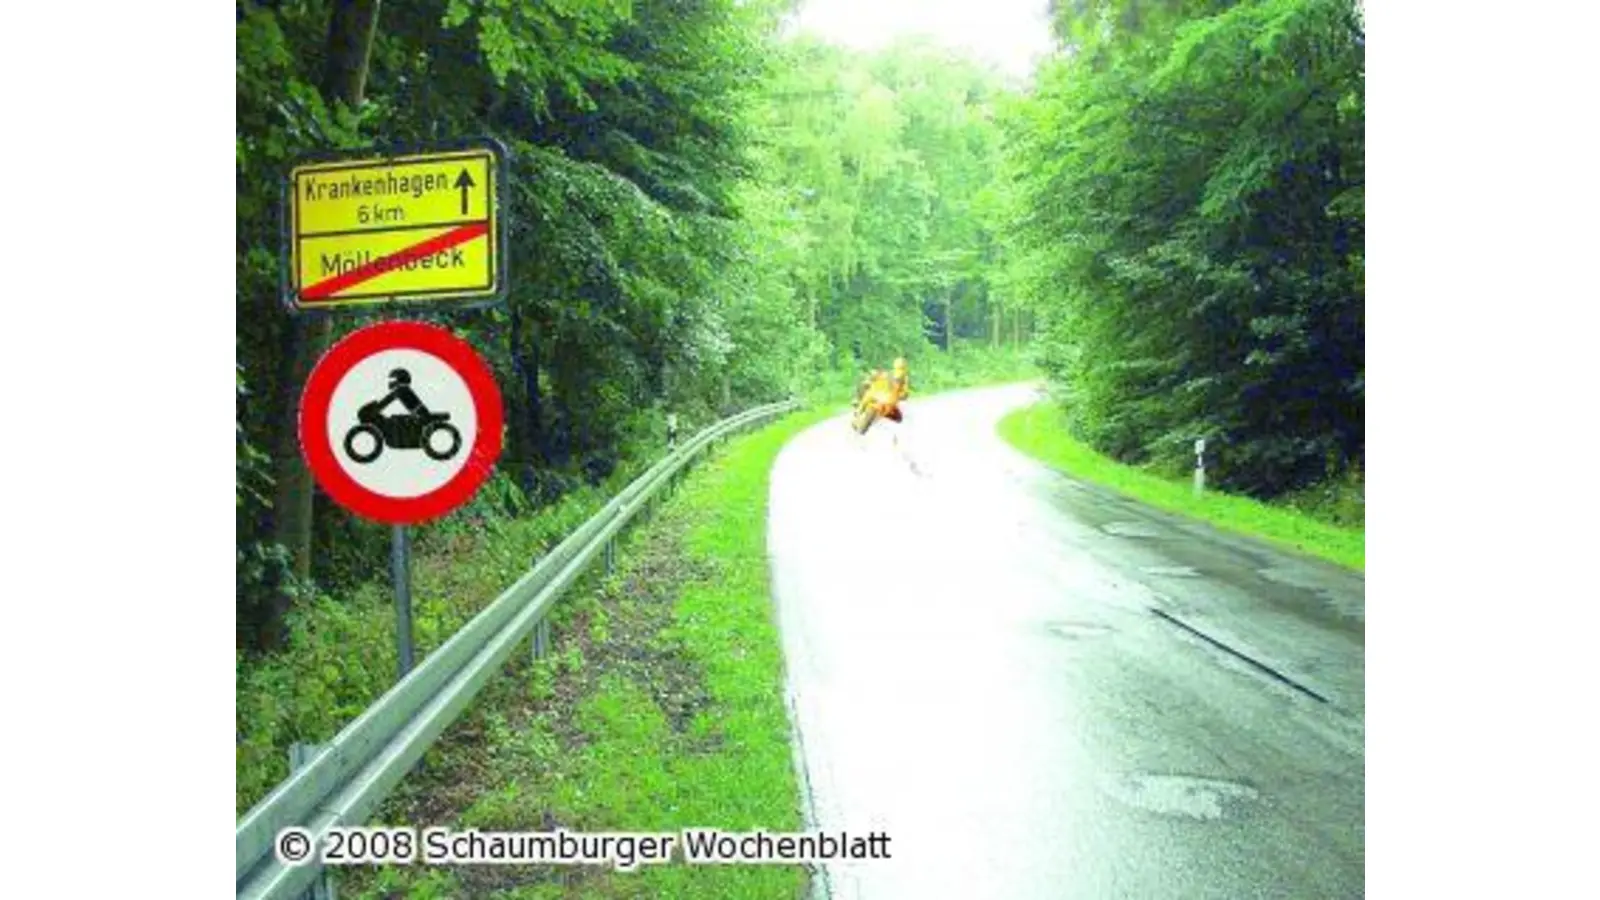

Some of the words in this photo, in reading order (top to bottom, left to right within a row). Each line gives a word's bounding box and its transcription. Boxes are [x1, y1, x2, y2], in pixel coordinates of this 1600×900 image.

[304, 171, 449, 201] Krankenhagen
[356, 205, 370, 224] 6
[372, 203, 405, 222] km
